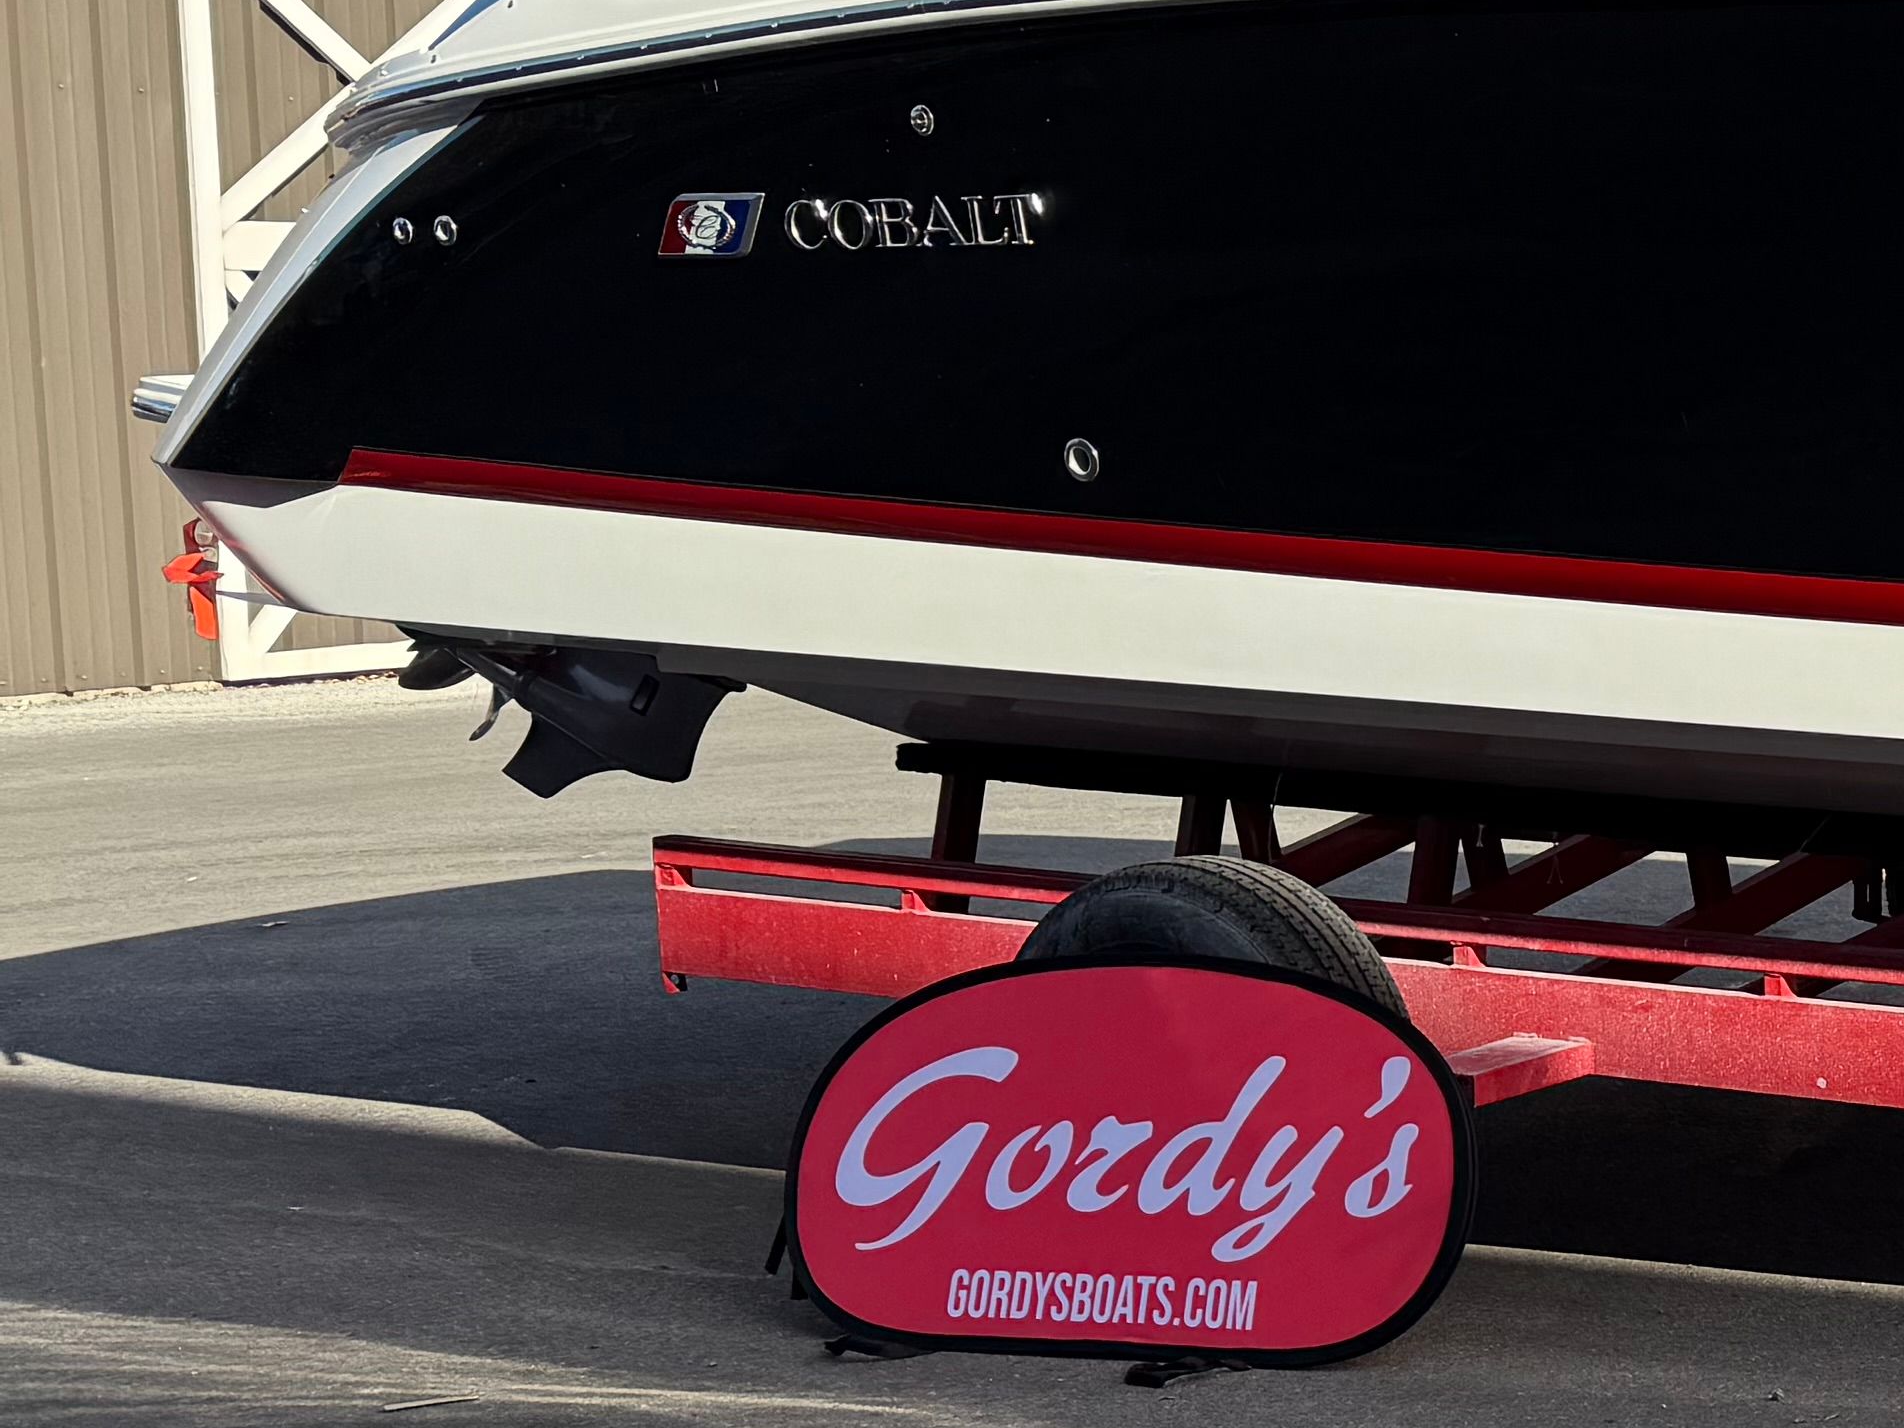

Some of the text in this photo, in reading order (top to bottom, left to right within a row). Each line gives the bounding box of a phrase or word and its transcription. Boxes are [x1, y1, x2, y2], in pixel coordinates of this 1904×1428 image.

[784, 193, 1041, 250] COBALT
[835, 1046, 1420, 1263] Gordy's
[947, 1268, 1258, 1331] GORDYSBOATS.COM
